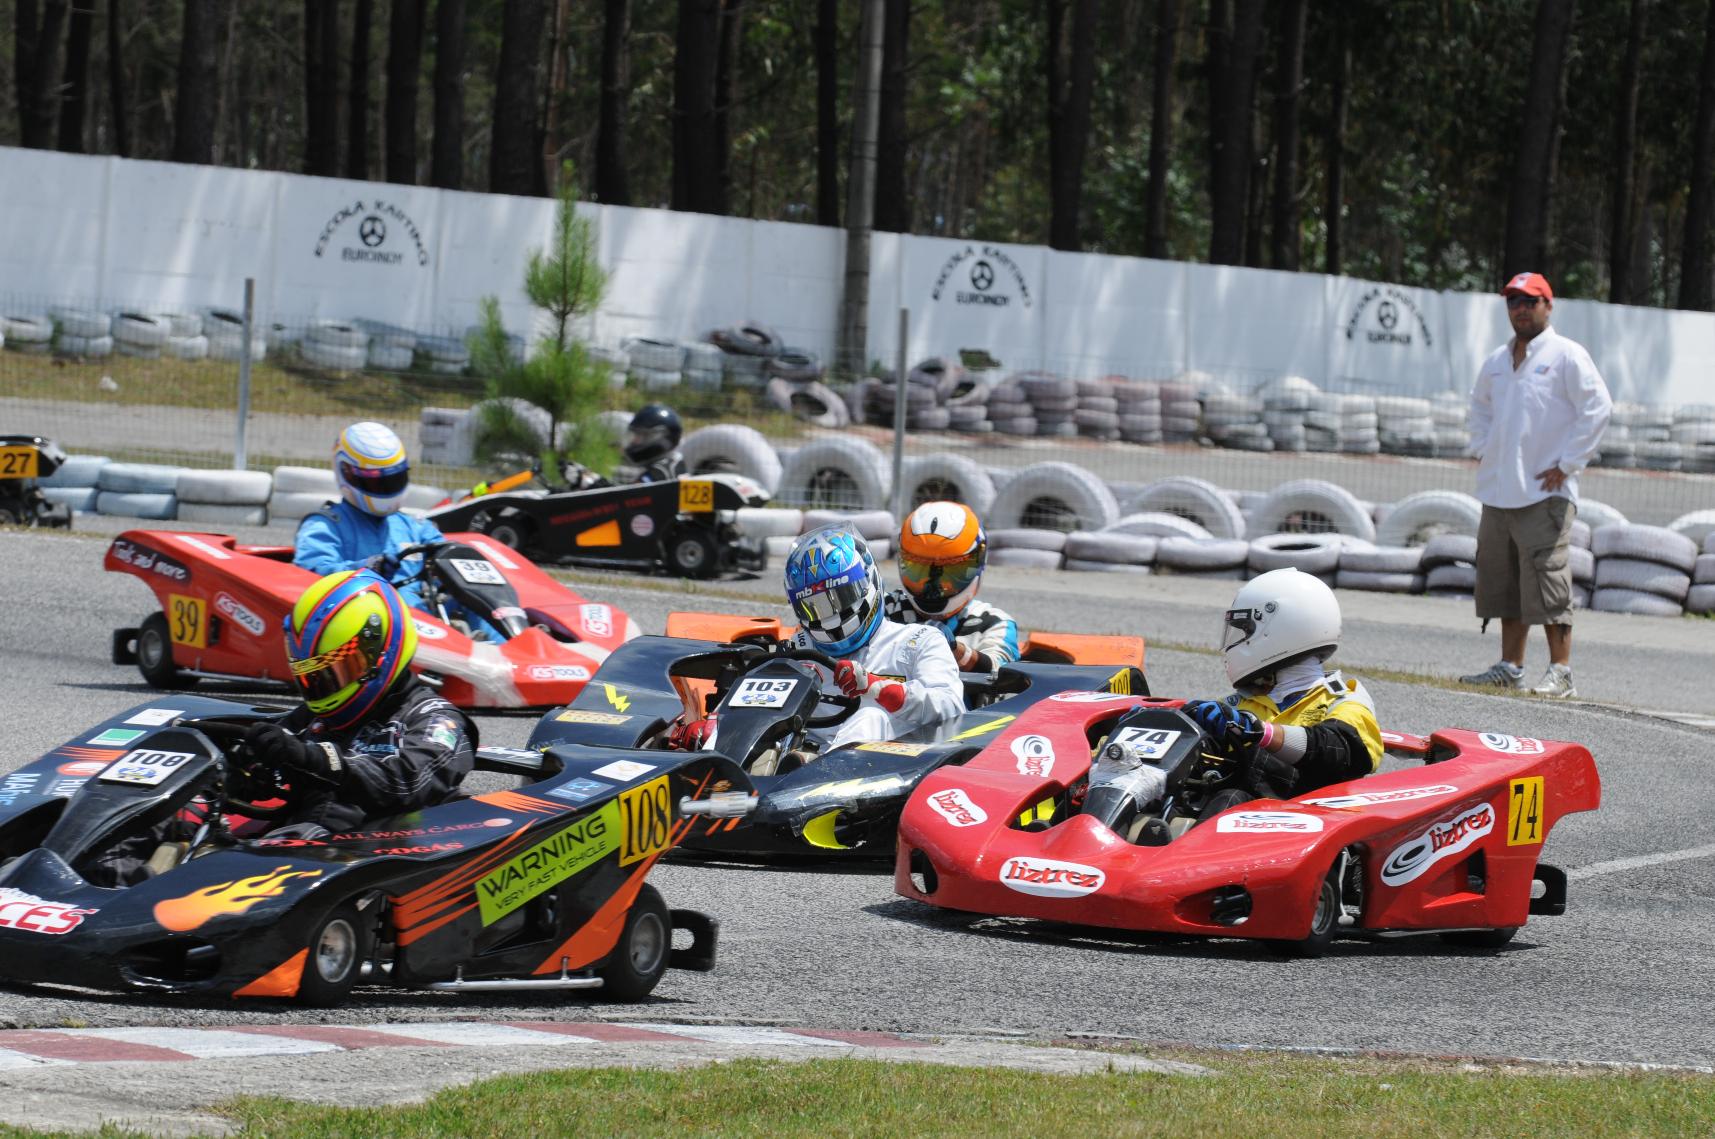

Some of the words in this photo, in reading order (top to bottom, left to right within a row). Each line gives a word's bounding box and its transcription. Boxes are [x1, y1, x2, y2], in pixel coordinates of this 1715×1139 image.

[683, 484, 711, 505] 128
[174, 600, 200, 642] 39
[745, 681, 792, 692] 103
[1124, 728, 1170, 745] 74
[128, 752, 186, 767] 108
[622, 783, 670, 859] 108
[1512, 783, 1538, 842] 74
[332, 831, 366, 841] ALL
[371, 828, 425, 839] WAYS
[1430, 808, 1492, 854] liztrez
[481, 815, 607, 897] WARNING
[495, 887, 527, 909] VERY
[528, 867, 557, 892] FAST
[558, 840, 608, 871] VEHICLE
[1005, 860, 1101, 887] liztrez
